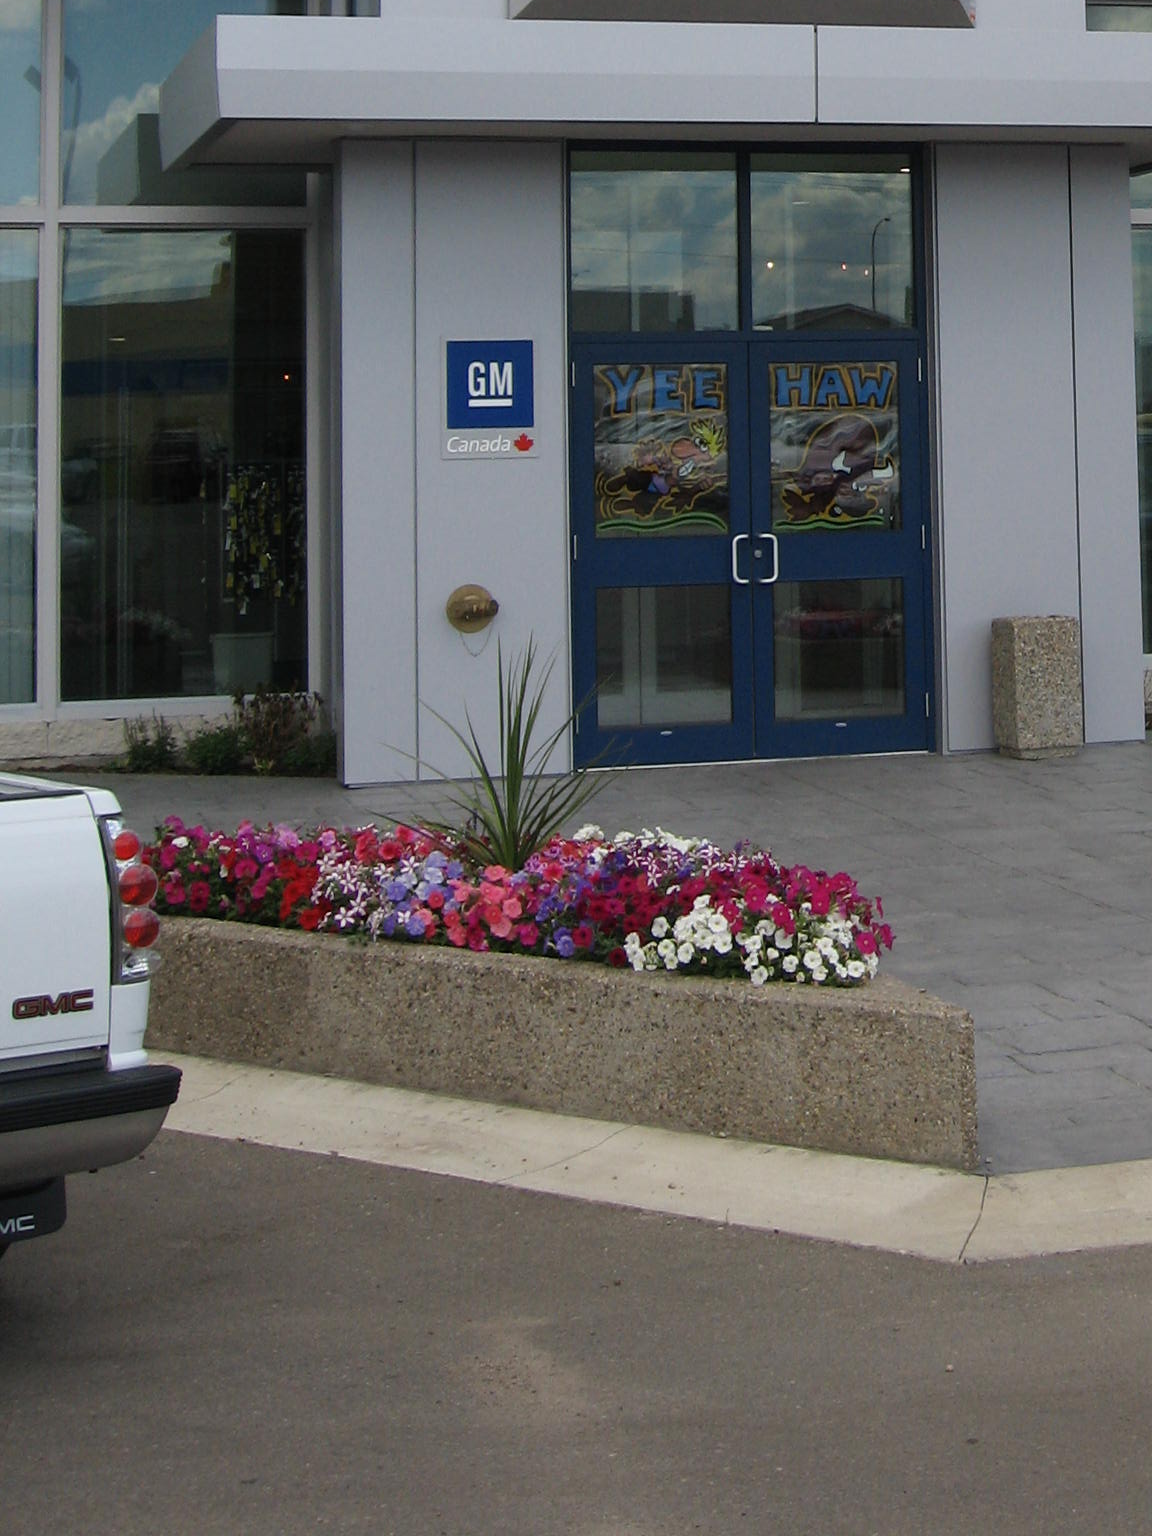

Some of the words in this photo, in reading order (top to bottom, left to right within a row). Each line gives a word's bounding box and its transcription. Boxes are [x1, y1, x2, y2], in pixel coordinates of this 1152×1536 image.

[467, 361, 513, 397] GM
[602, 366, 727, 414] YEE
[771, 365, 897, 410] HAW
[446, 434, 512, 453] Canada
[12, 988, 94, 1020] GMC
